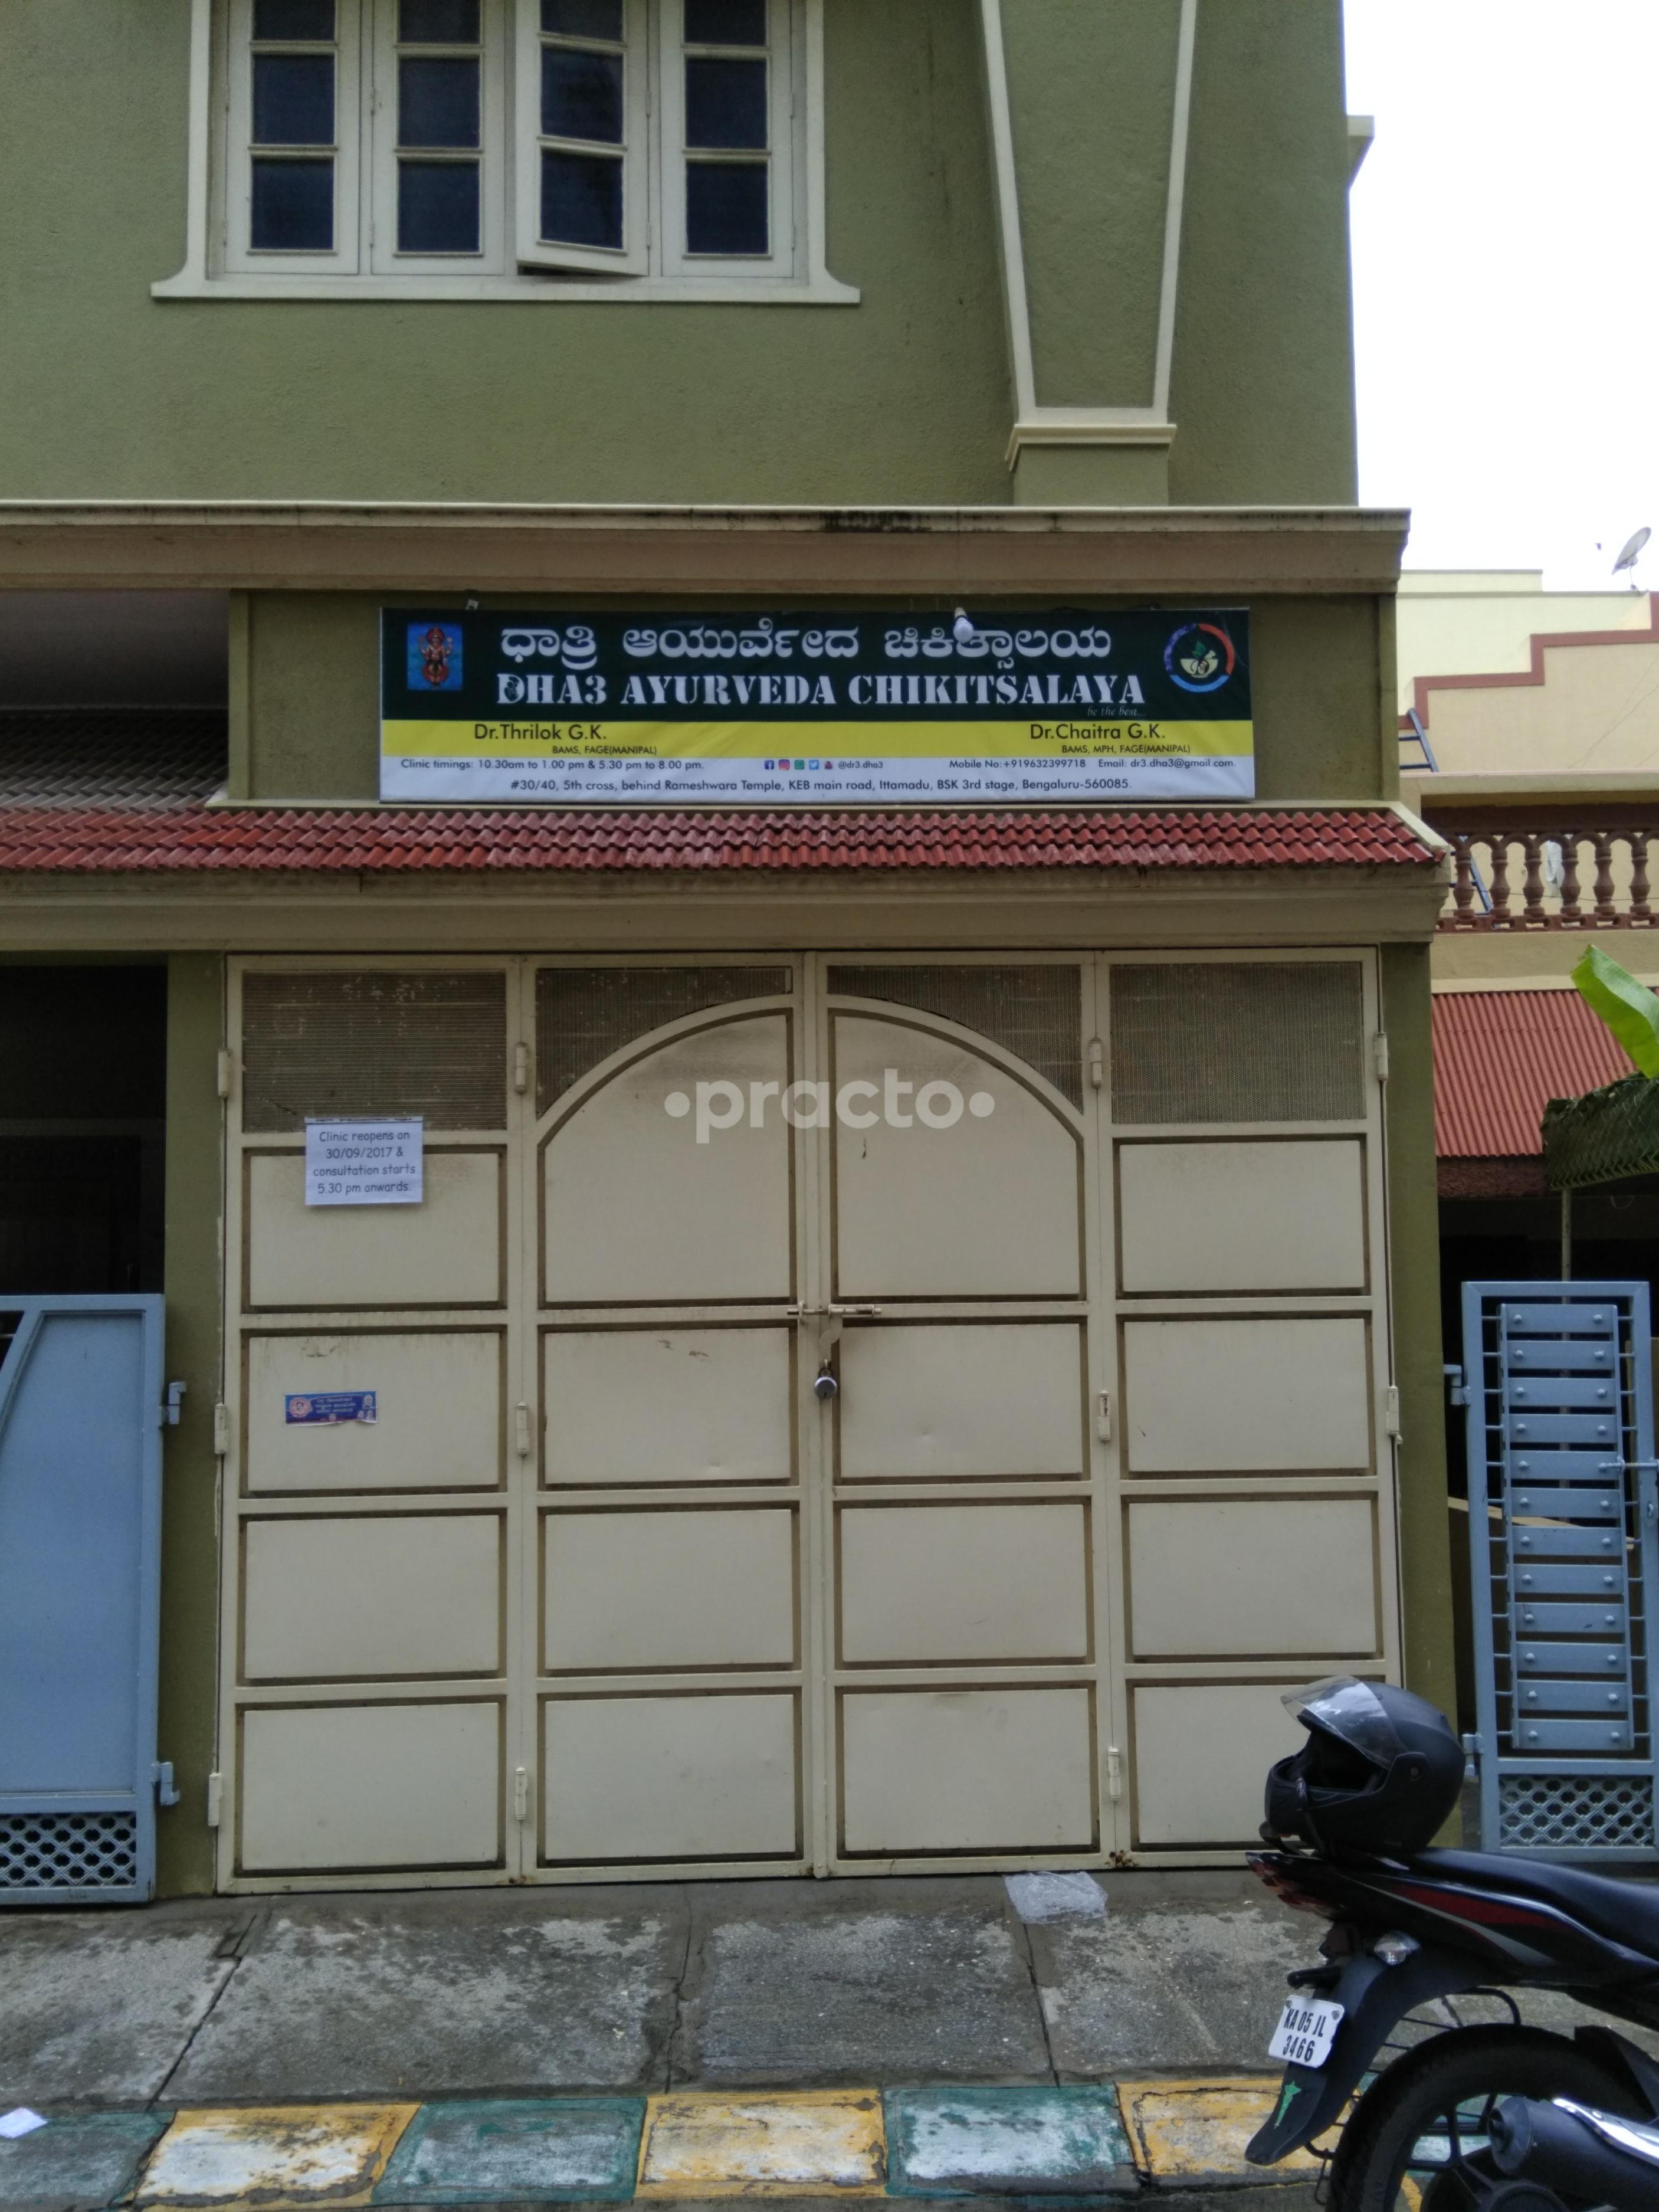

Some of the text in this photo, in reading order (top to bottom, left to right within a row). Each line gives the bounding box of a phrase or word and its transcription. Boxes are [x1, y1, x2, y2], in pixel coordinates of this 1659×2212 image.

[500, 618, 1112, 670] ಧಾತ್ರಿ ಆಯುರ್ವೇದ ಚಿಕಿತ್ಸಾಲಯ
[496, 673, 1146, 705] DHA3 AYURVEDA CHIKITSALAYA
[474, 723, 607, 740] Dr.Thrilok G.K.
[1030, 723, 1166, 739] Dr.Chaitra G.K.
[552, 745, 657, 756] BAMS, FAGE(MANIPAL)
[1061, 745, 1191, 754] BAMS, MPH, FAGE(MANIPAL)
[401, 759, 704, 771] Clinic timings: 10.30am to 1.00 pm & 5.30 pm to 8.00 pm.
[838, 760, 883, 769] @dr3.dha3
[949, 759, 982, 768] Mobile
[1098, 759, 1127, 768] Email:
[510, 779, 559, 791] #30/40,
[563, 779, 582, 790] 5th
[586, 782, 618, 791] cross,
[621, 779, 661, 790] behind
[665, 779, 737, 790] Rameshwara
[742, 779, 785, 792] Temple,
[789, 780, 810, 790] KEB
[814, 780, 842, 790] main
[846, 779, 876, 791] road,
[880, 779, 933, 791] Ittamadu,
[937, 779, 958, 789] BSK
[962, 779, 981, 789] 3rd
[985, 779, 1018, 792] stage,
[319, 1131, 409, 1143] Clinic reopens on
[326, 1146, 404, 1159] 30/09/2017 &
[313, 1164, 416, 1177] consultation starts
[317, 1181, 411, 1195] 5.30 pm onwards.
[1283, 2008, 1327, 2037] KA 05 JL
[1282, 2034, 1316, 2062] 3466
